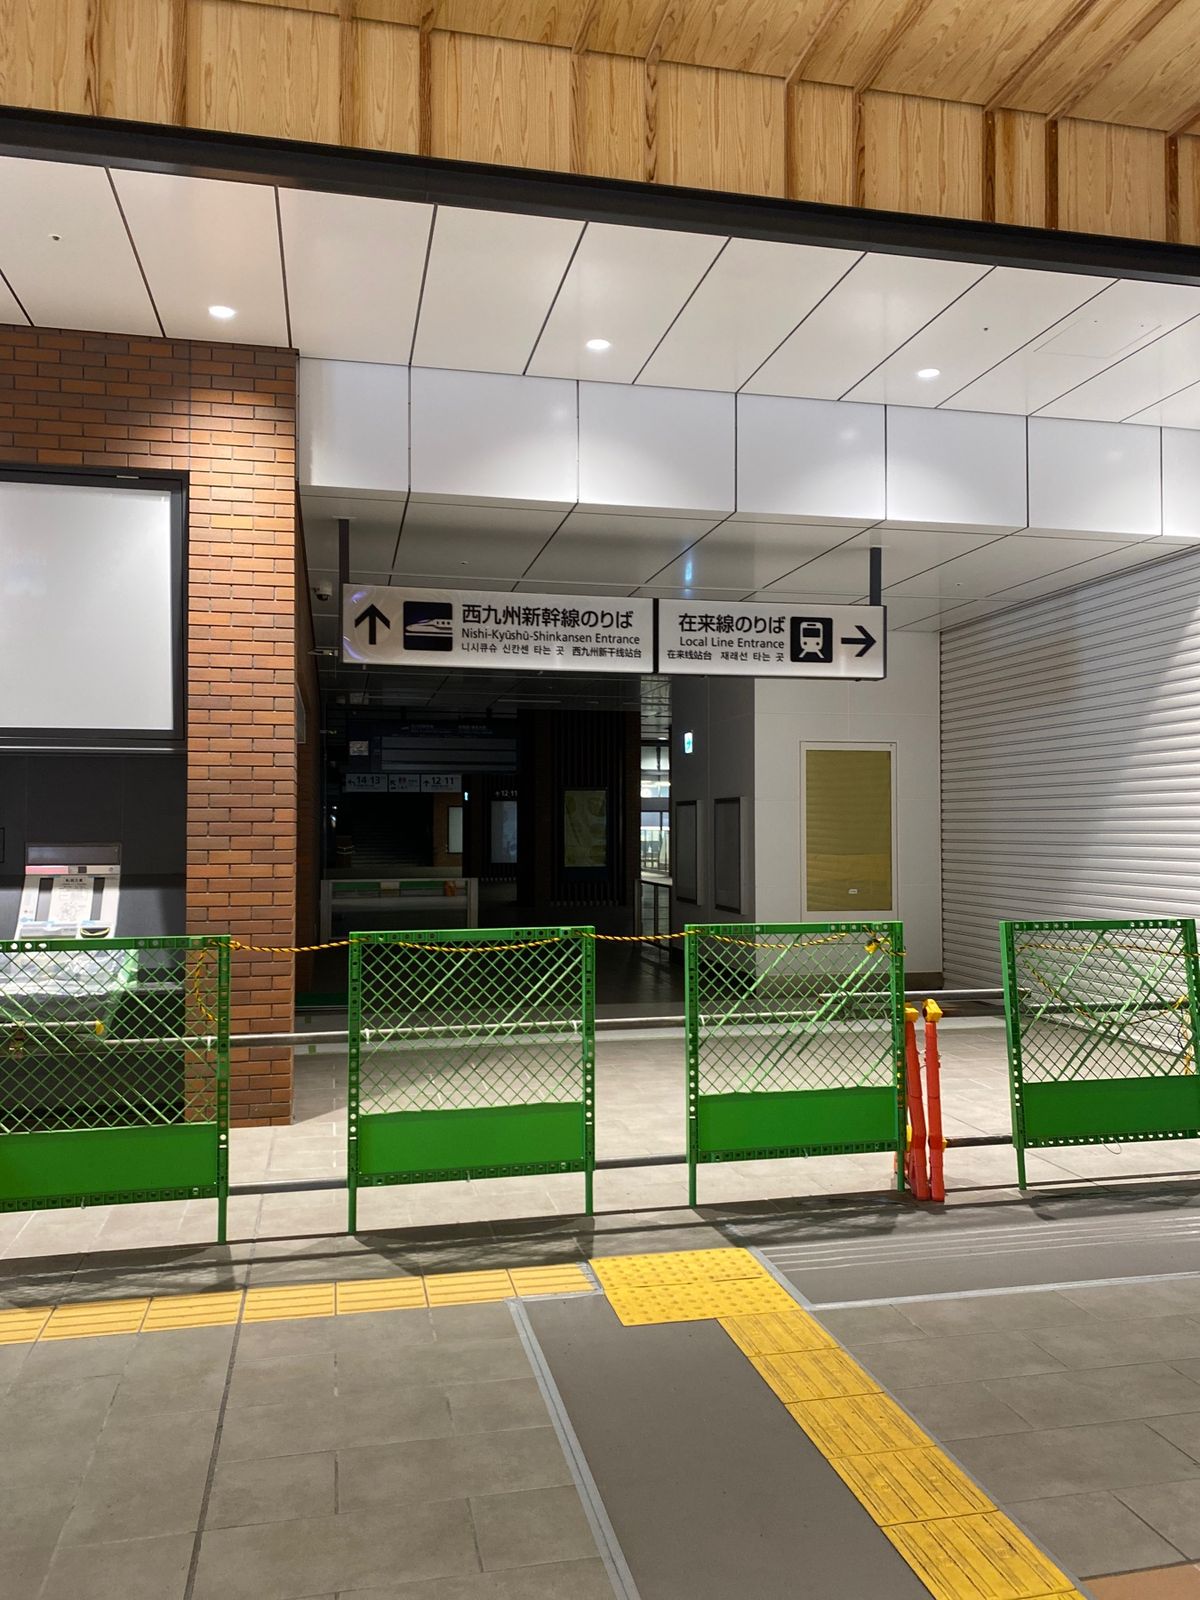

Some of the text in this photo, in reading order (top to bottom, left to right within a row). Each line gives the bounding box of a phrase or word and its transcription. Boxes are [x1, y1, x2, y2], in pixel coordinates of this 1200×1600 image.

[462, 604, 634, 629] 西九州新幹線のりば
[678, 612, 786, 634] 在来線のりば
[461, 627, 640, 644] Nishi-Kyūshū-Shinkansen Entrance
[680, 636, 785, 649] Local Line Entrance
[461, 643, 565, 656] 니시큐슈 신칸센 타는 곳
[572, 646, 642, 658] 西九州新干线站台
[667, 650, 712, 661] 在来线站台
[720, 651, 784, 662] 재래선 타는 곳
[431, 776, 441, 785] 12
